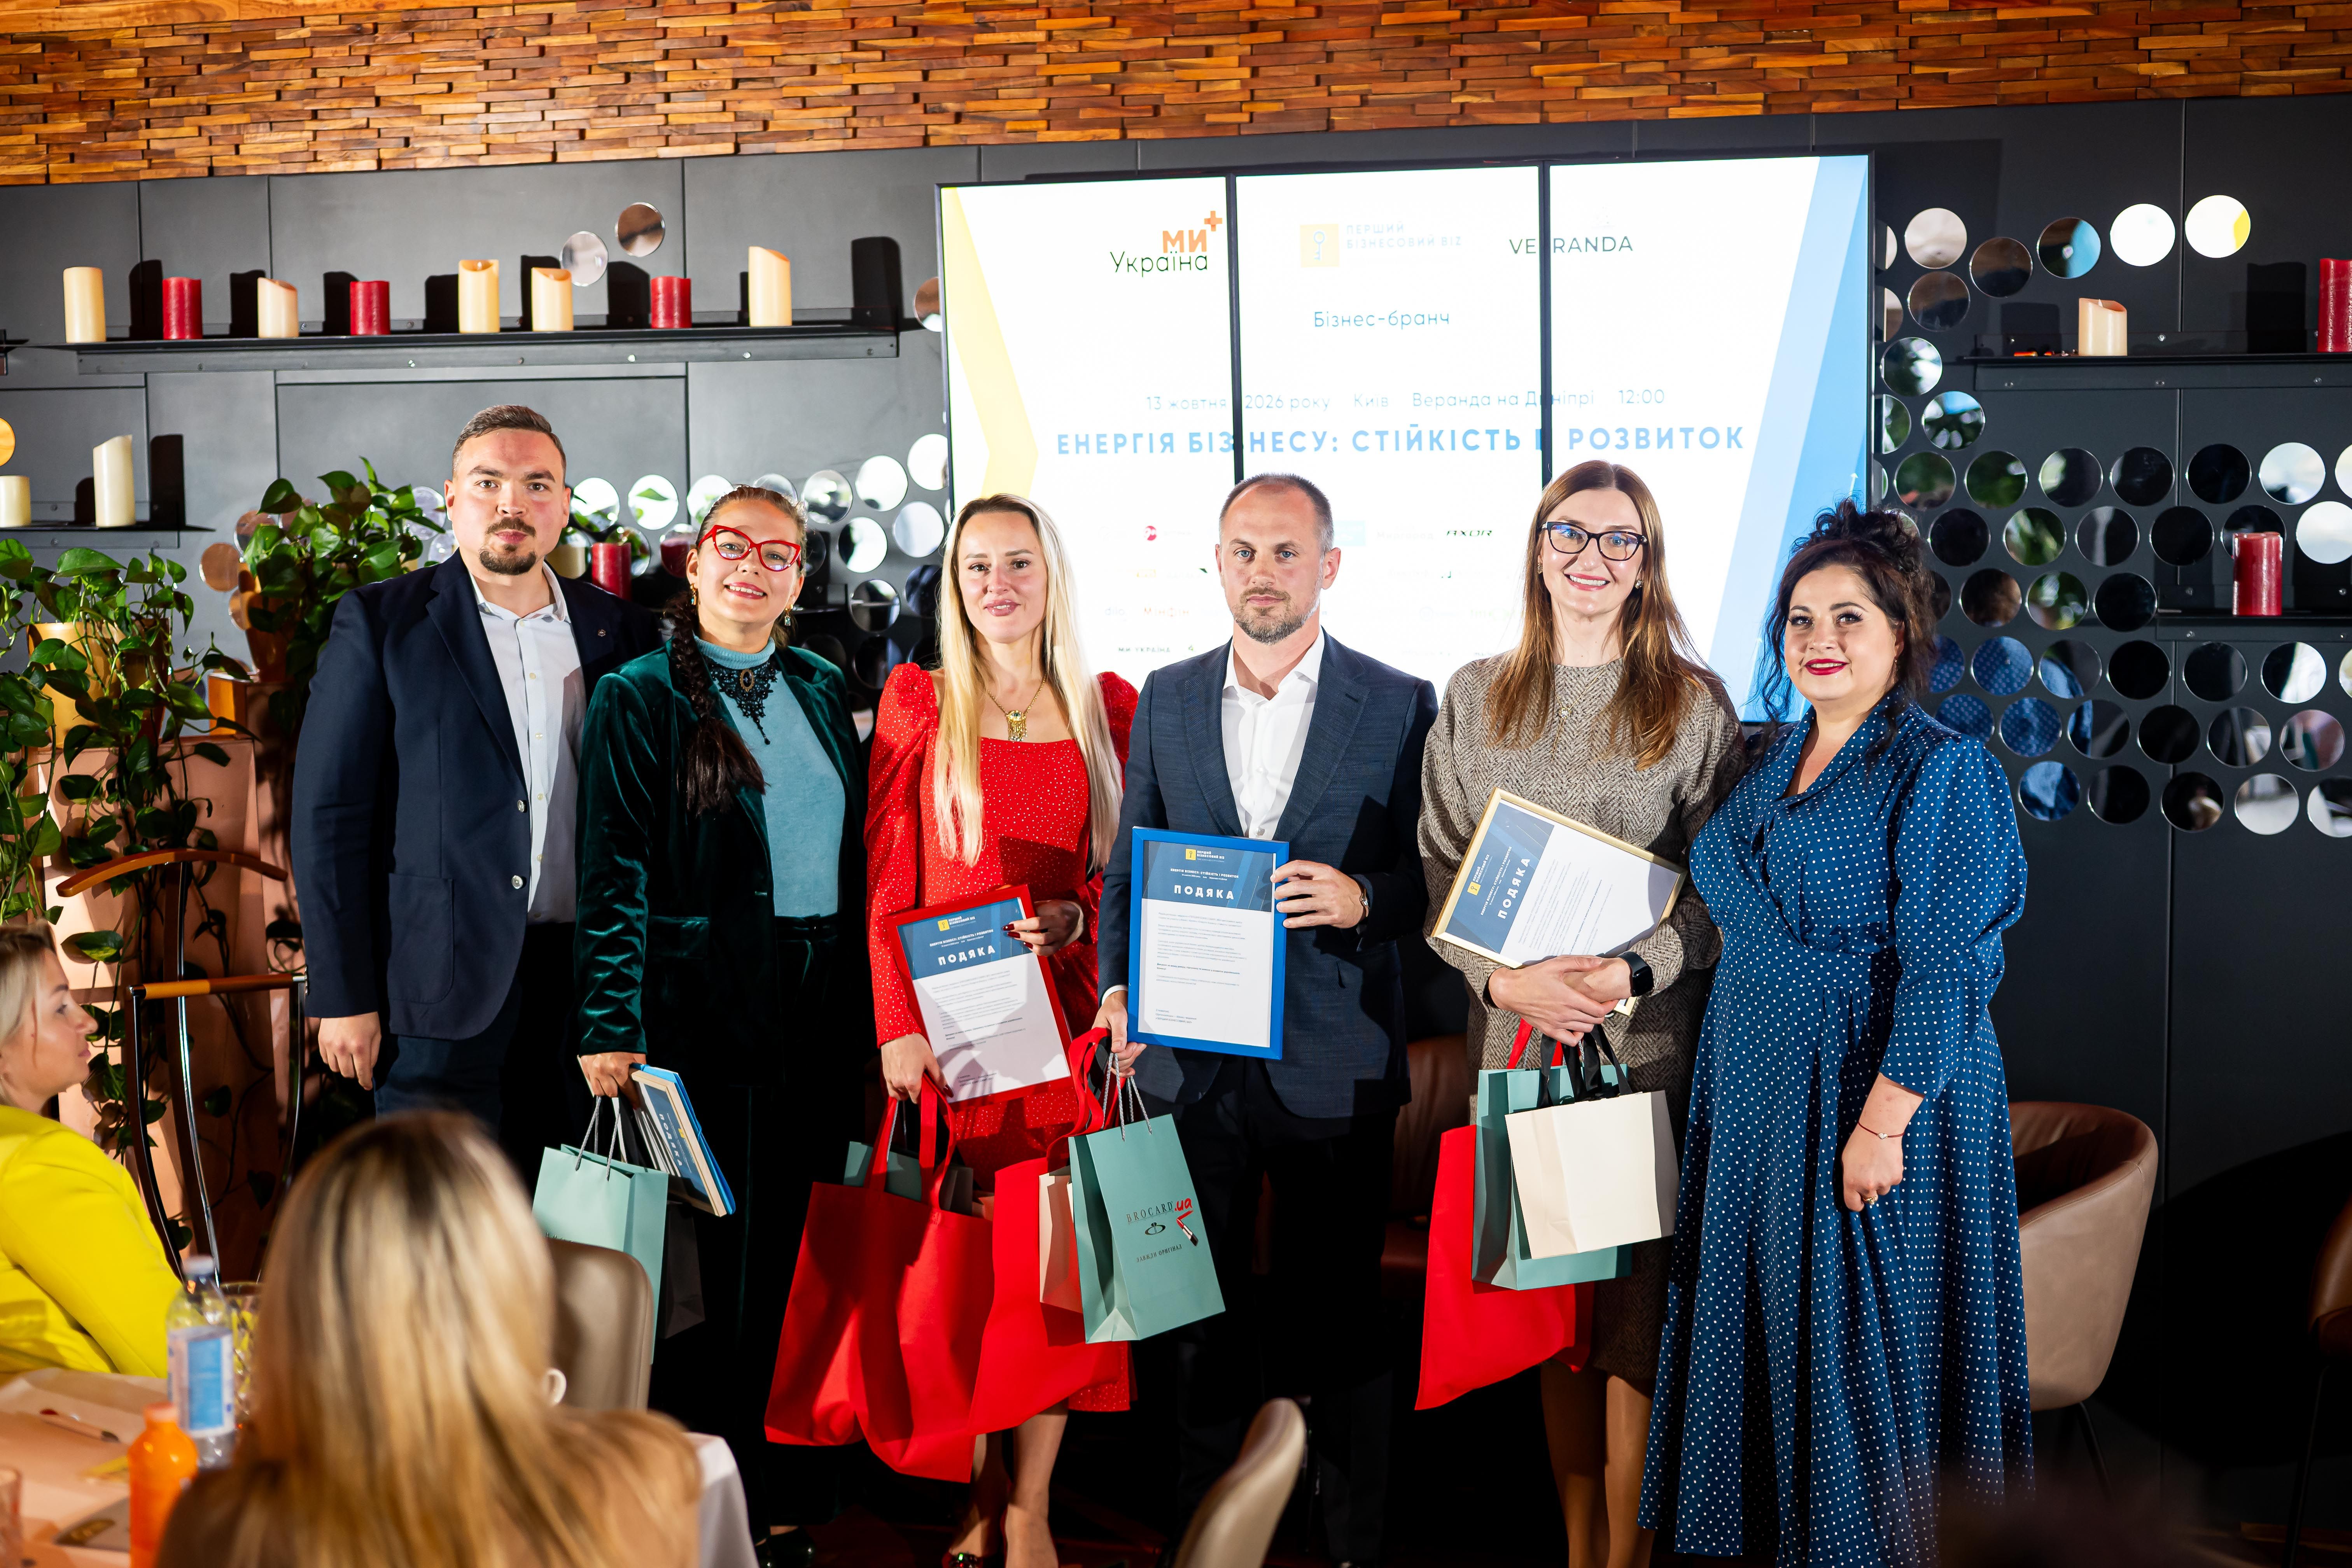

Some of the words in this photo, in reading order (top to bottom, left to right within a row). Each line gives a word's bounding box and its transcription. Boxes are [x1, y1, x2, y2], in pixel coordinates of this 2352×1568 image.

[1347, 220, 1404, 234] ПЕРШИЙ
[1347, 234, 1435, 249] БІЗНЕСОВИЙ
[1110, 251, 1207, 277] Україна
[1314, 310, 1450, 330] Бізнес-бранч
[1146, 396, 1162, 410] 13
[1168, 399, 1227, 410] жовтня
[1245, 394, 1284, 409] 2026
[1290, 397, 1331, 412] року
[1354, 393, 1389, 408] Київ
[1413, 392, 1491, 410] Веранда
[1498, 394, 1518, 406] на
[1618, 389, 1665, 404] 12:00
[1057, 432, 1174, 454] ЕНЕРГІЯ
[1188, 431, 1338, 453] БІЗНЕСУ:
[1352, 424, 1521, 452] СТІЙКІСТЬ
[1569, 426, 1743, 450] РОЗВИТОК
[1174, 885, 1234, 900] ПОДЯКА
[1497, 858, 1530, 919] ПОДЯКА
[938, 945, 996, 966] ПОДЯКА
